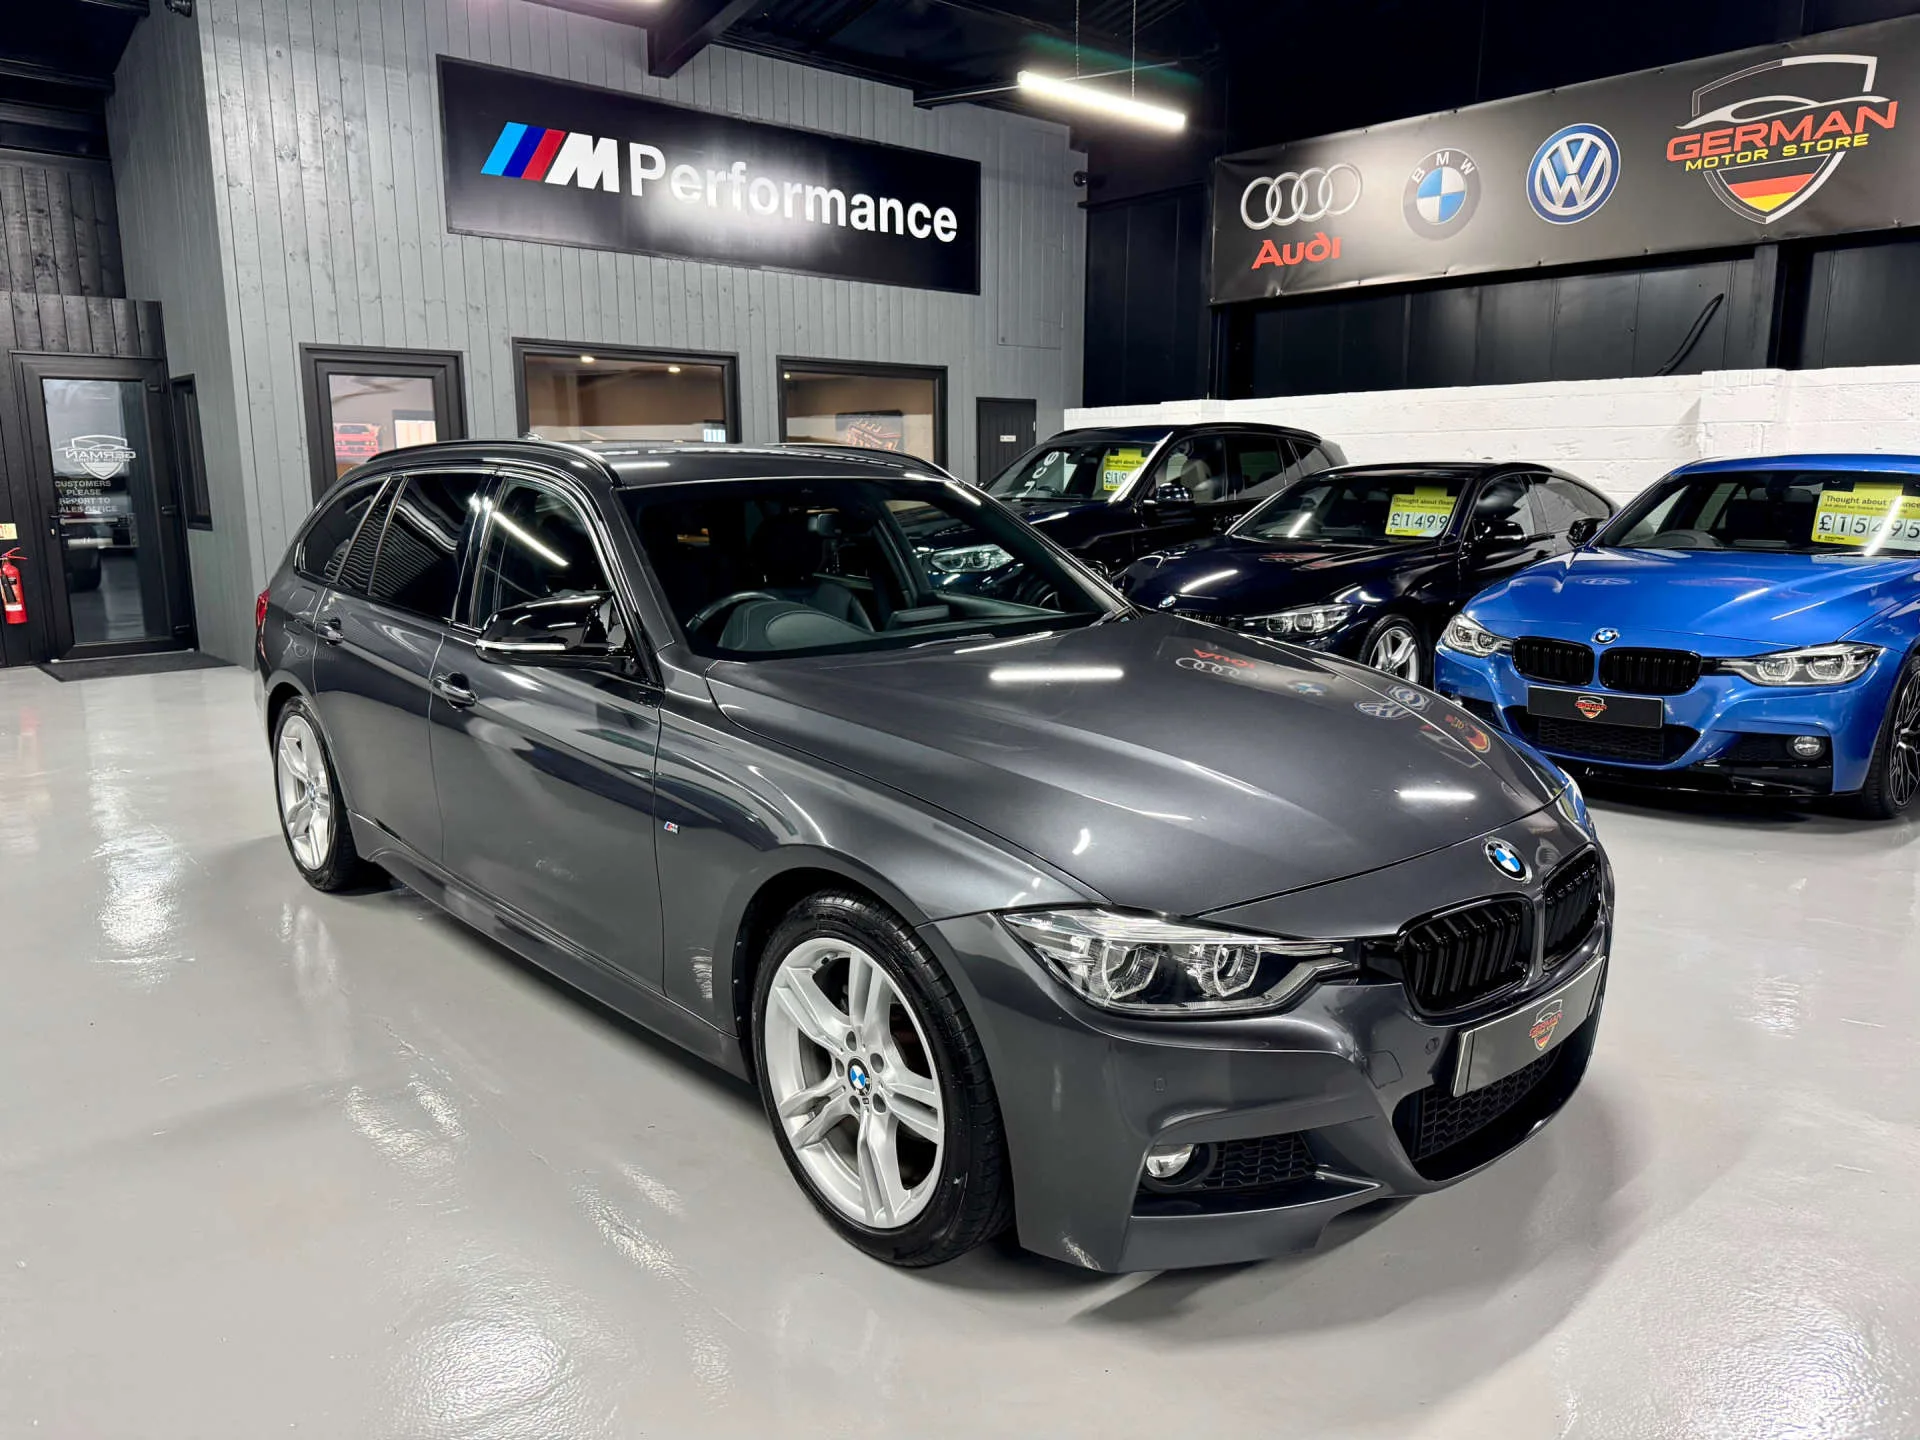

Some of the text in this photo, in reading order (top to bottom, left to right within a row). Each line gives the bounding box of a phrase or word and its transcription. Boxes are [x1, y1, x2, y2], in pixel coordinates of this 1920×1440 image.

[1666, 101, 1898, 162] GERMAN
[1411, 151, 1475, 184] BMW
[1685, 133, 1870, 171] MOTOR STORE
[629, 142, 957, 243] Performance
[1251, 232, 1342, 270] Audi
[1827, 495, 1860, 505] Thought
